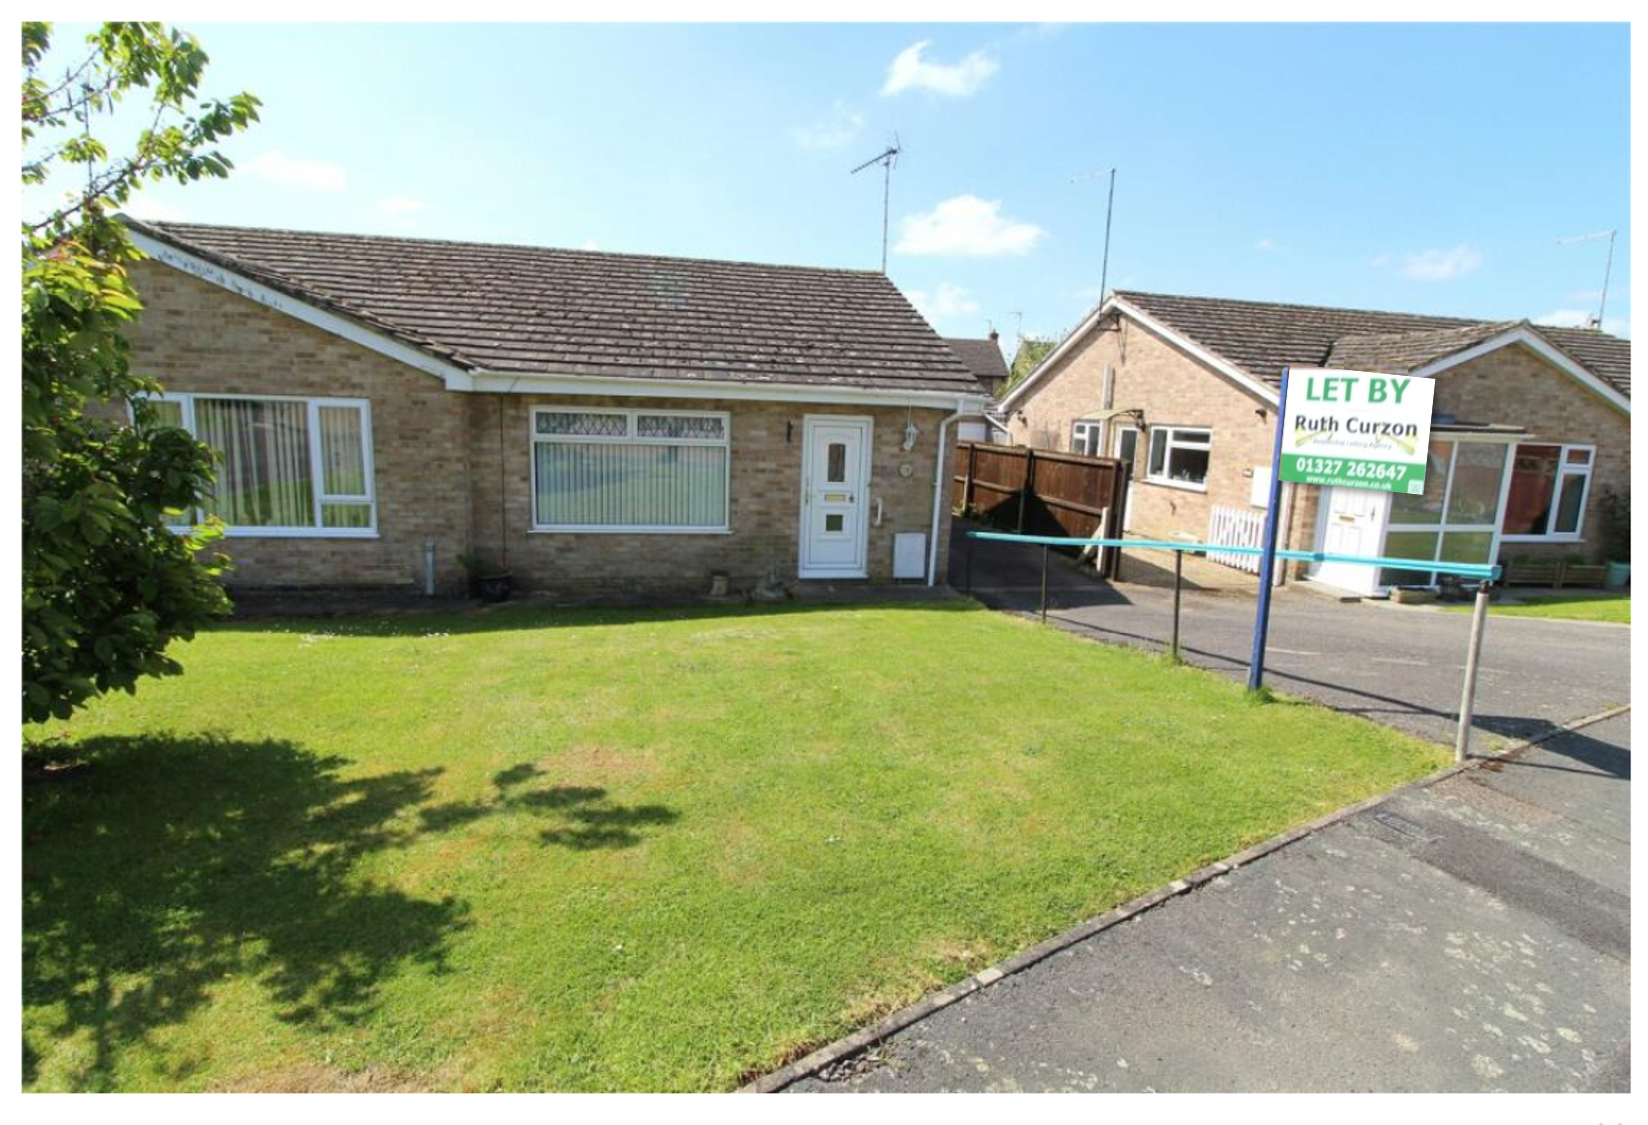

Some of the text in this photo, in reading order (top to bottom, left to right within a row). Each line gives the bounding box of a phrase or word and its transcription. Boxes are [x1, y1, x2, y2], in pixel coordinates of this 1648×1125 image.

[1306, 377, 1411, 404] LET BY
[1295, 415, 1418, 437] Ruth Curzon
[1296, 457, 1407, 481] 01327 262647
[1306, 475, 1392, 491] www.ruthcurzon.co.uk
